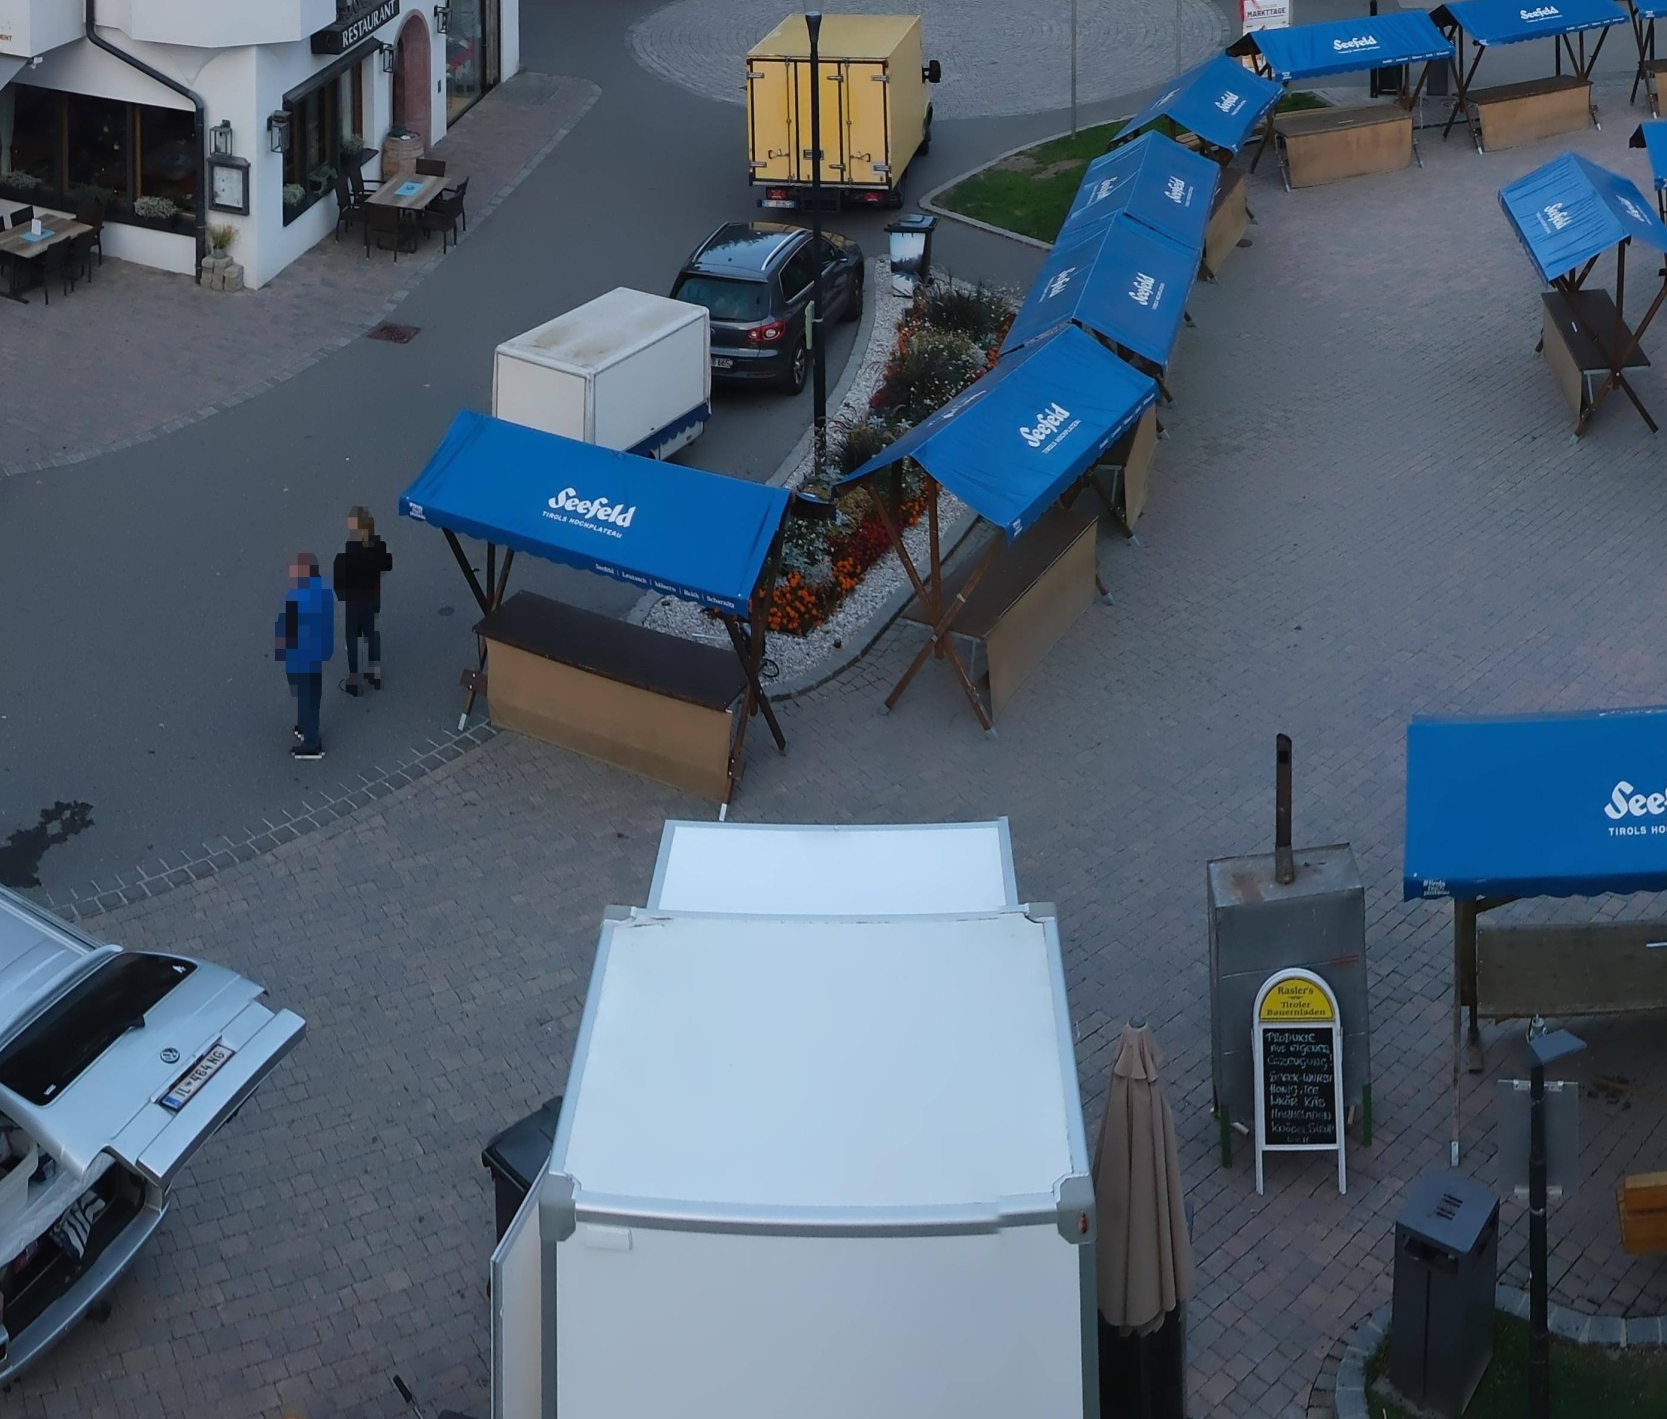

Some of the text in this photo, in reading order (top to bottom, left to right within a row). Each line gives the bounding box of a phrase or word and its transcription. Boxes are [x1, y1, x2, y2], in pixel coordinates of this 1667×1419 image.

[1247, 7, 1286, 18] MARKTTAGE
[1520, 5, 1559, 20] Seefeld
[1333, 35, 1378, 51] Seefeld
[1020, 402, 1070, 448] Seefeld
[549, 487, 636, 527] Seefeld
[1608, 825, 1647, 836] TIROLS
